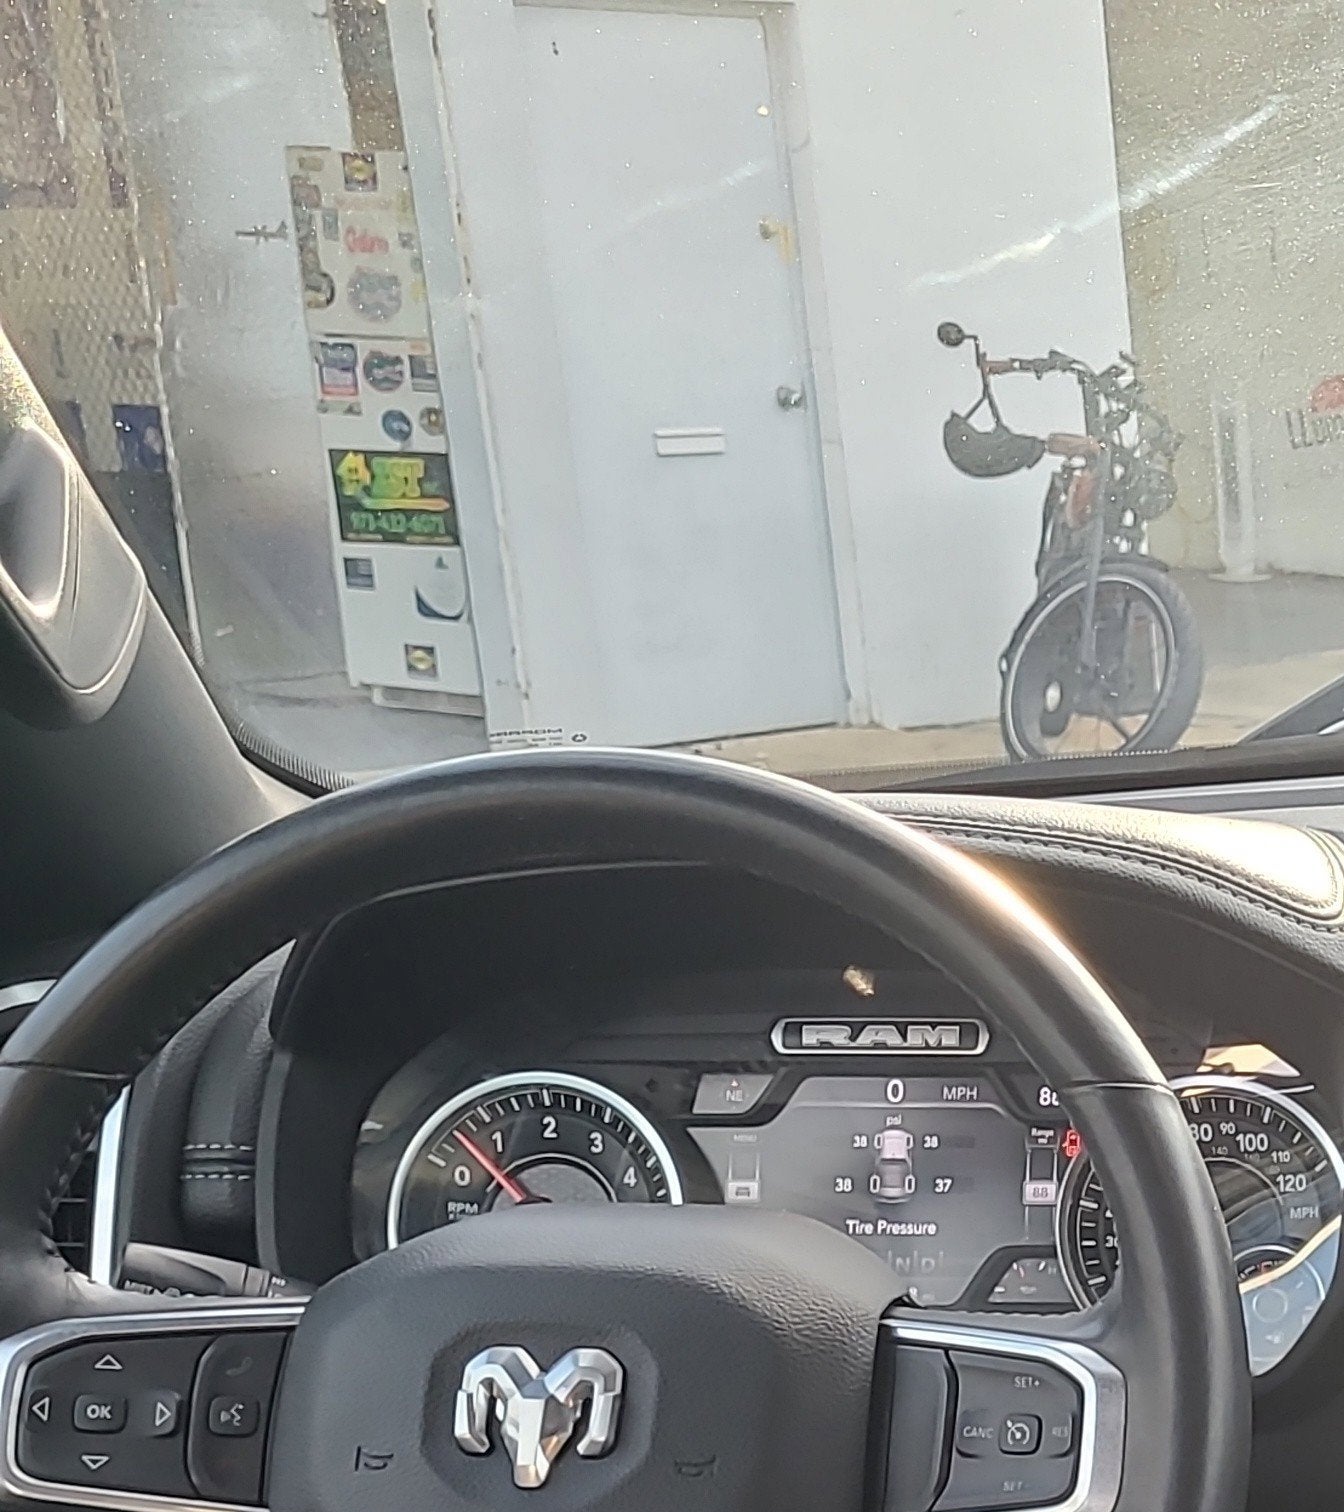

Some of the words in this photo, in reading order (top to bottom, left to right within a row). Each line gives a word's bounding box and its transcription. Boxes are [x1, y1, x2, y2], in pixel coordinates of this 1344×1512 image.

[802, 1024, 960, 1047] RAM
[886, 1078, 904, 1103] 0
[942, 1085, 978, 1101] MPH
[542, 1116, 558, 1138] 2
[1219, 1121, 1236, 1135] 90
[491, 1130, 503, 1152] 1
[589, 1131, 604, 1153] 3
[1235, 1132, 1269, 1153] 100
[1270, 1150, 1291, 1163] 110
[454, 1165, 471, 1187] 0
[623, 1166, 638, 1188] 4
[934, 1178, 952, 1193] 37
[1275, 1173, 1307, 1193] 120
[447, 1202, 479, 1214] RPM
[1289, 1206, 1319, 1220] MPH
[846, 1219, 874, 1235] Tire
[877, 1219, 937, 1236] Pressure
[86, 1404, 112, 1420] OK
